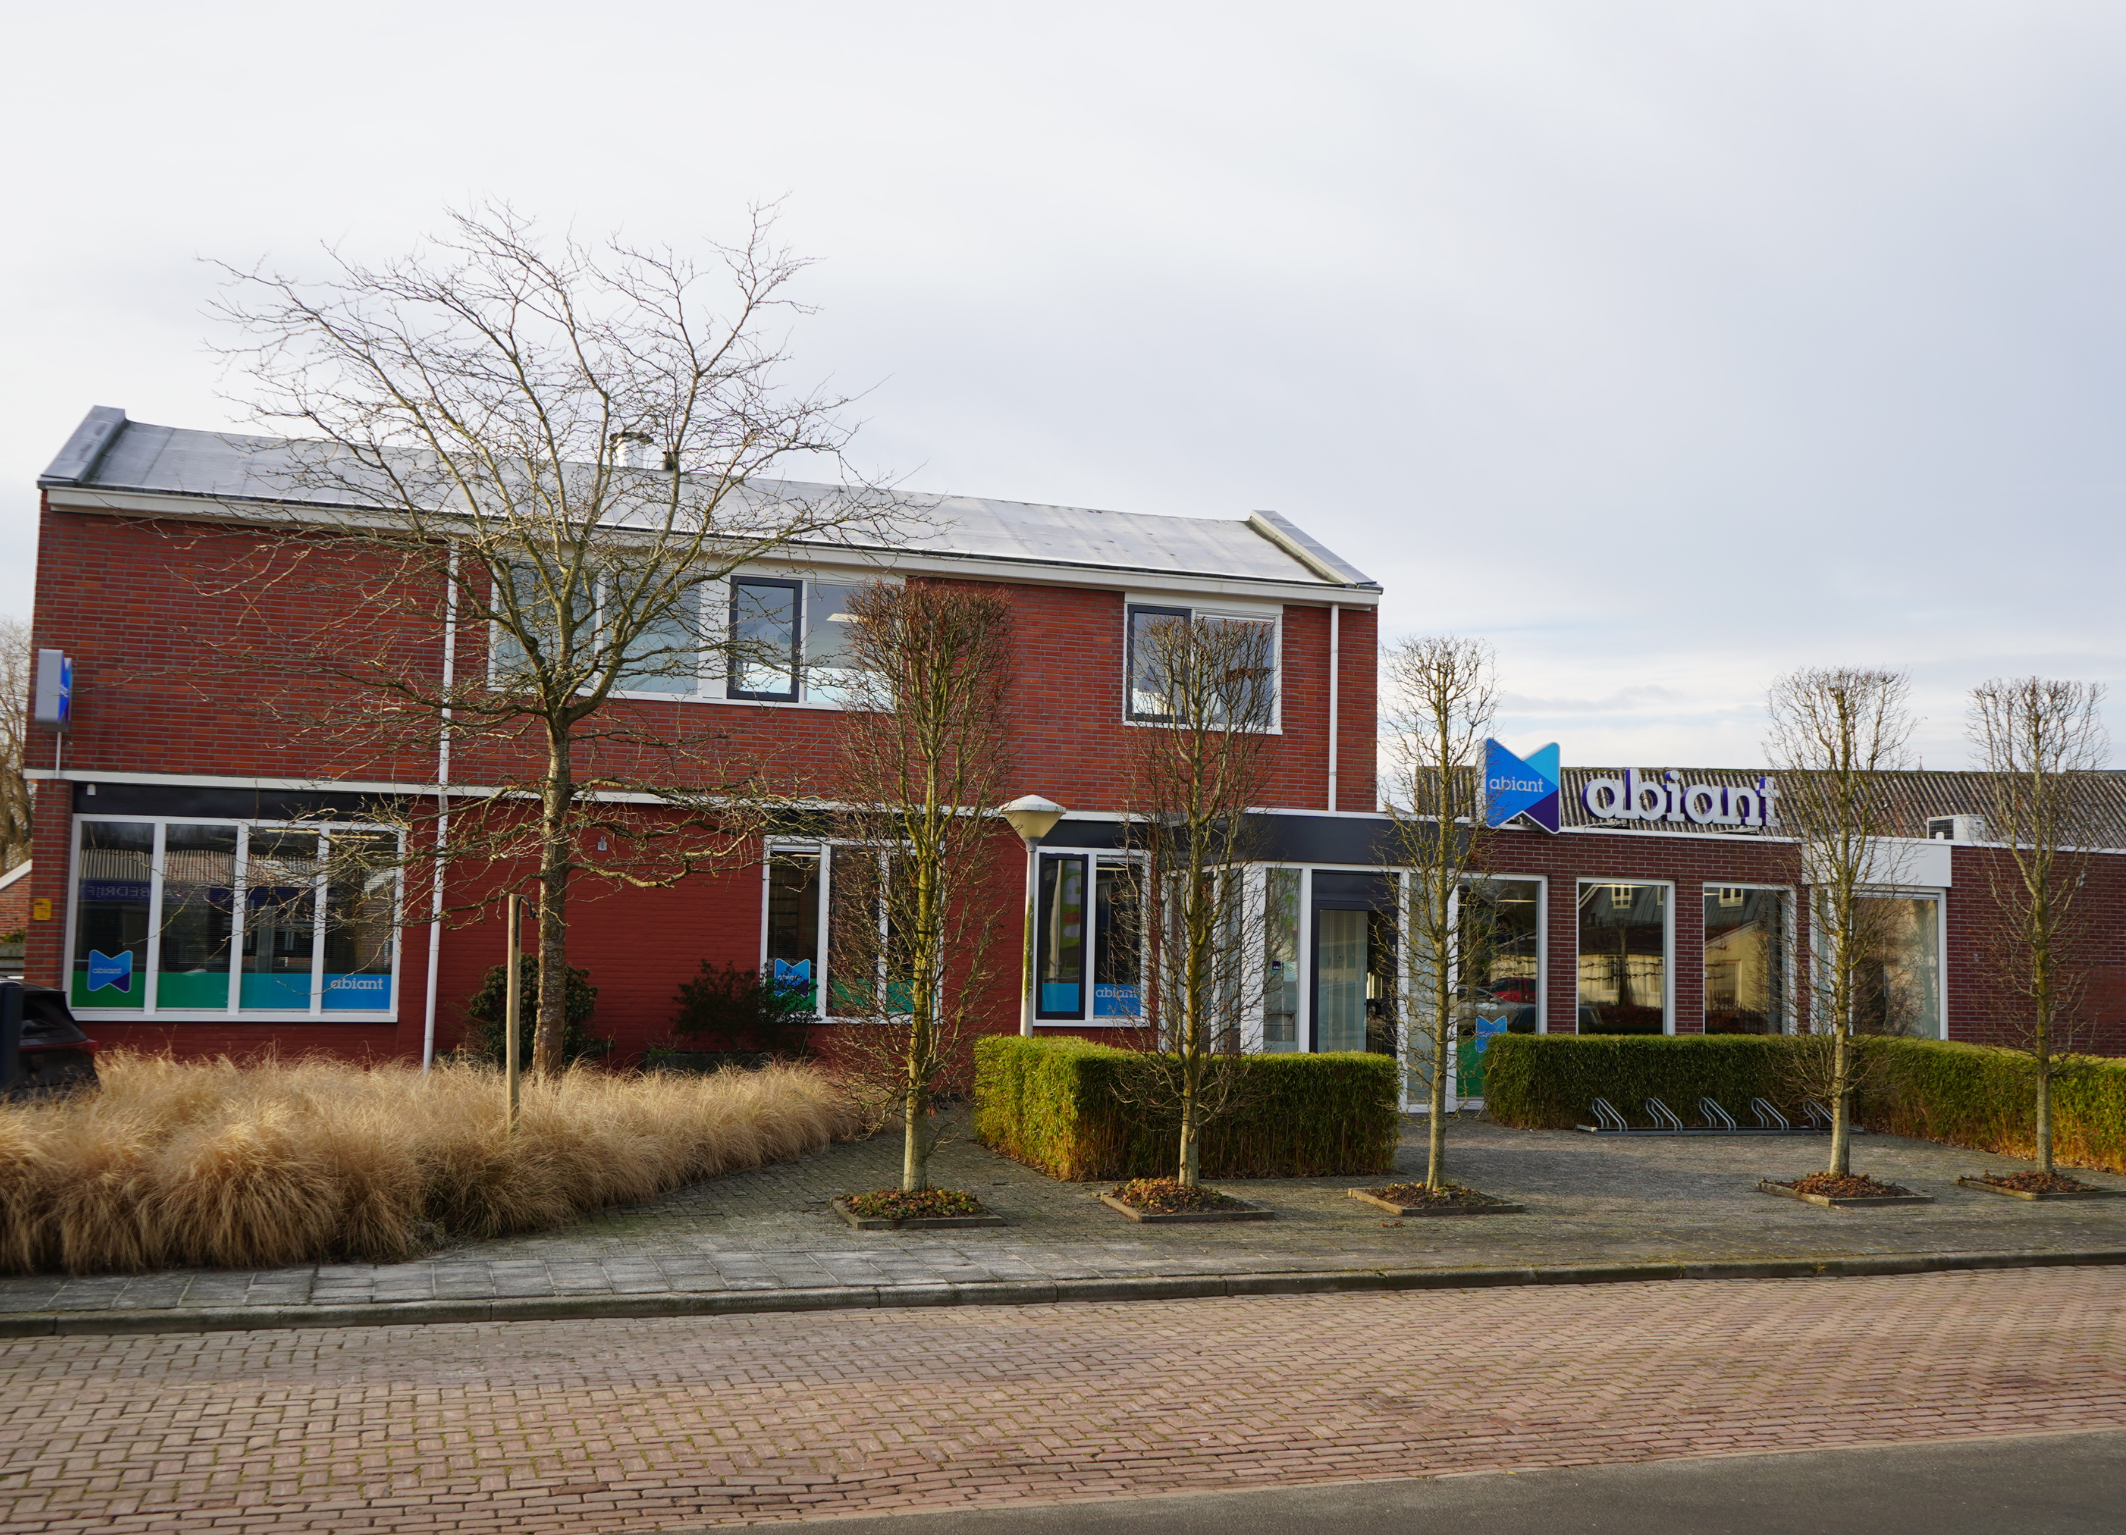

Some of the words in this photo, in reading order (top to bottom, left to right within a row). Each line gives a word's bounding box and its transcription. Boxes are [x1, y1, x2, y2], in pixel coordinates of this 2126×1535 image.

[1489, 776, 1544, 793] abiant
[1582, 768, 1780, 827] abiant
[330, 977, 384, 990] abiant
